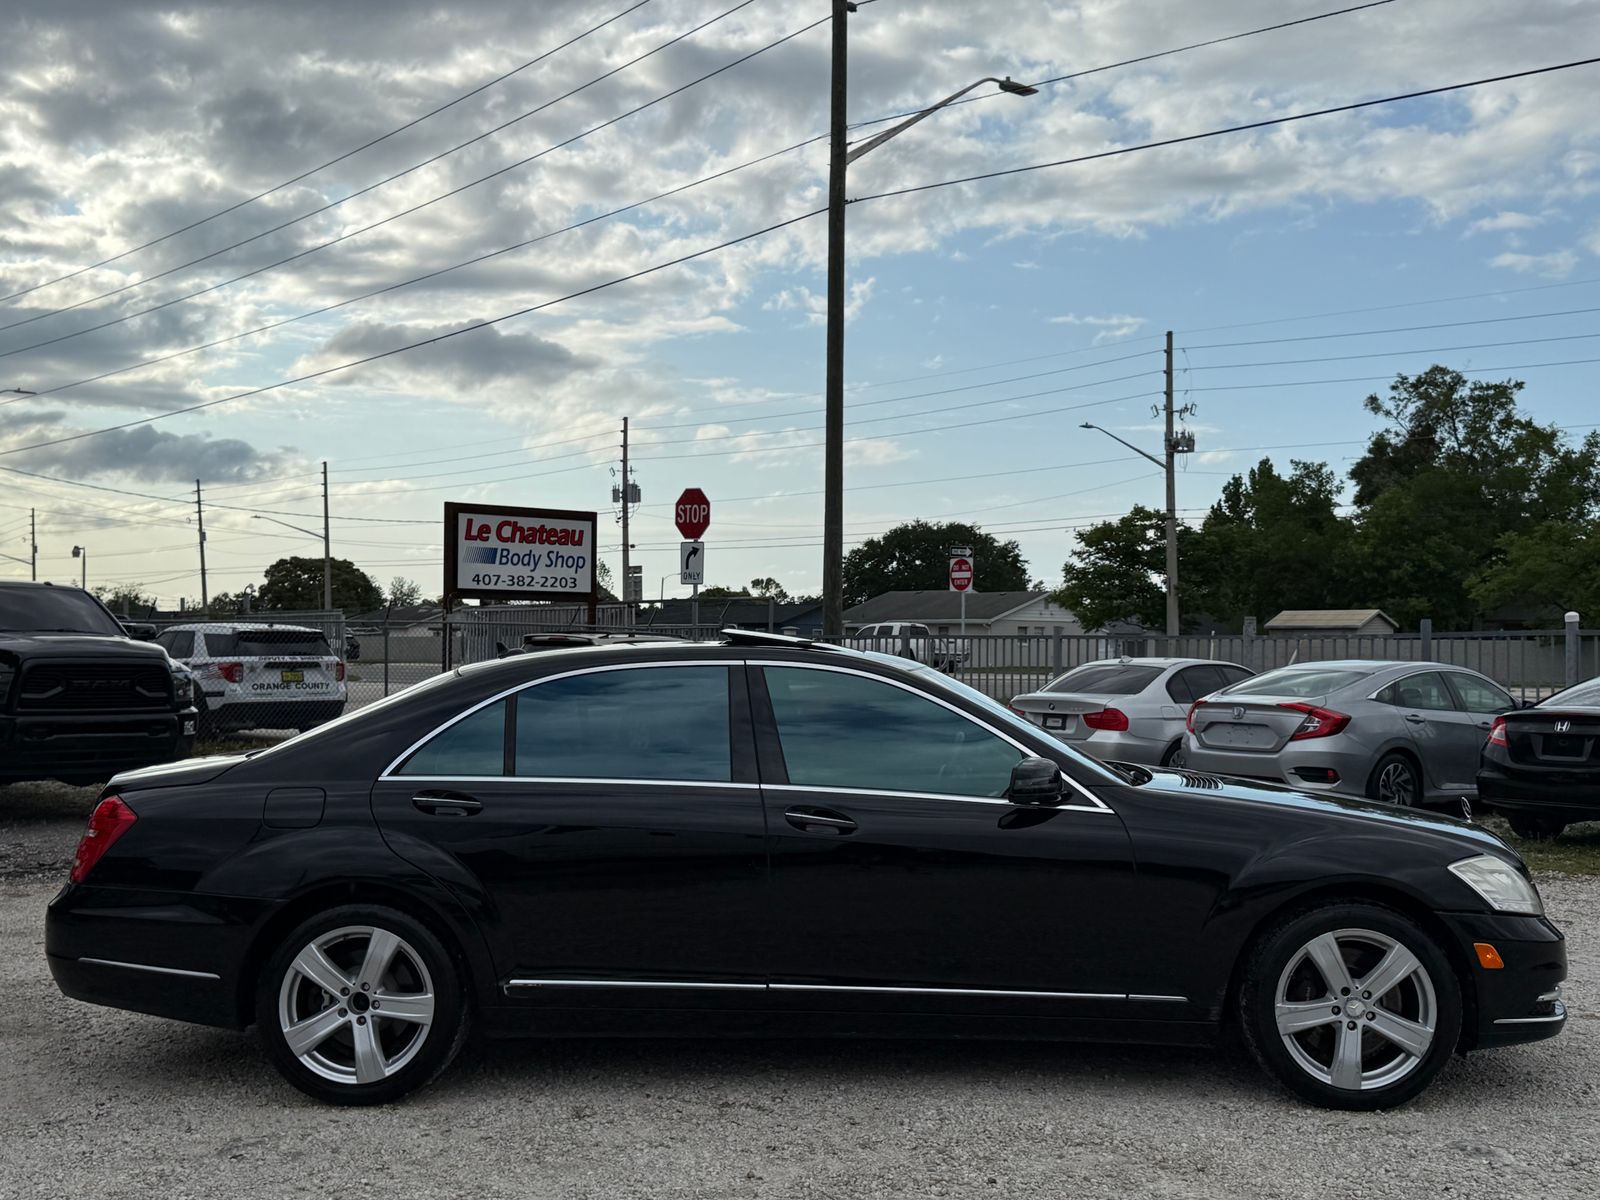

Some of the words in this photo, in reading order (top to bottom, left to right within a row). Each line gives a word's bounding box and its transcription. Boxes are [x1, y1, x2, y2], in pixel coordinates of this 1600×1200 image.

[677, 504, 708, 523] STOP
[464, 518, 492, 542] Le
[495, 520, 585, 547] Chateau
[499, 548, 542, 572] Body
[545, 550, 586, 574] Shop
[472, 573, 578, 589] 407-382-2203
[683, 571, 701, 580] ONLY
[252, 682, 293, 691] ORANGE
[295, 682, 331, 690] COUNTY
